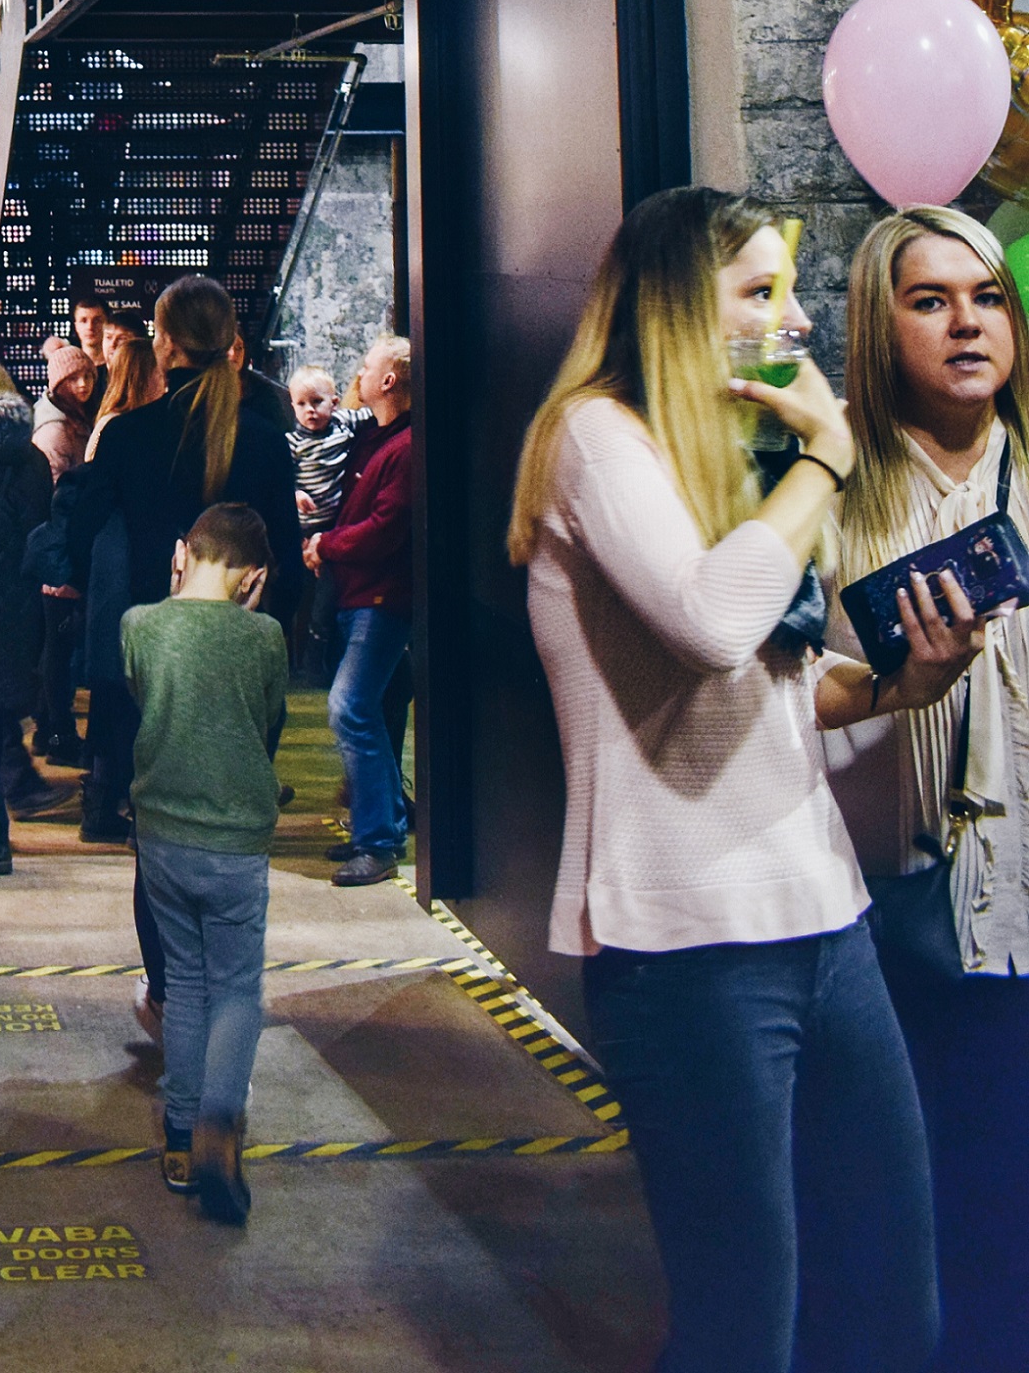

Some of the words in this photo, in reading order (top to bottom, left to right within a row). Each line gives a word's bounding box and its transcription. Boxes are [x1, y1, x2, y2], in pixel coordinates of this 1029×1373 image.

[94, 278, 134, 287] TUALETID
[121, 300, 142, 309] SAAL
[12, 1246, 141, 1262] DOORS
[0, 1263, 147, 1283] CLEAR
